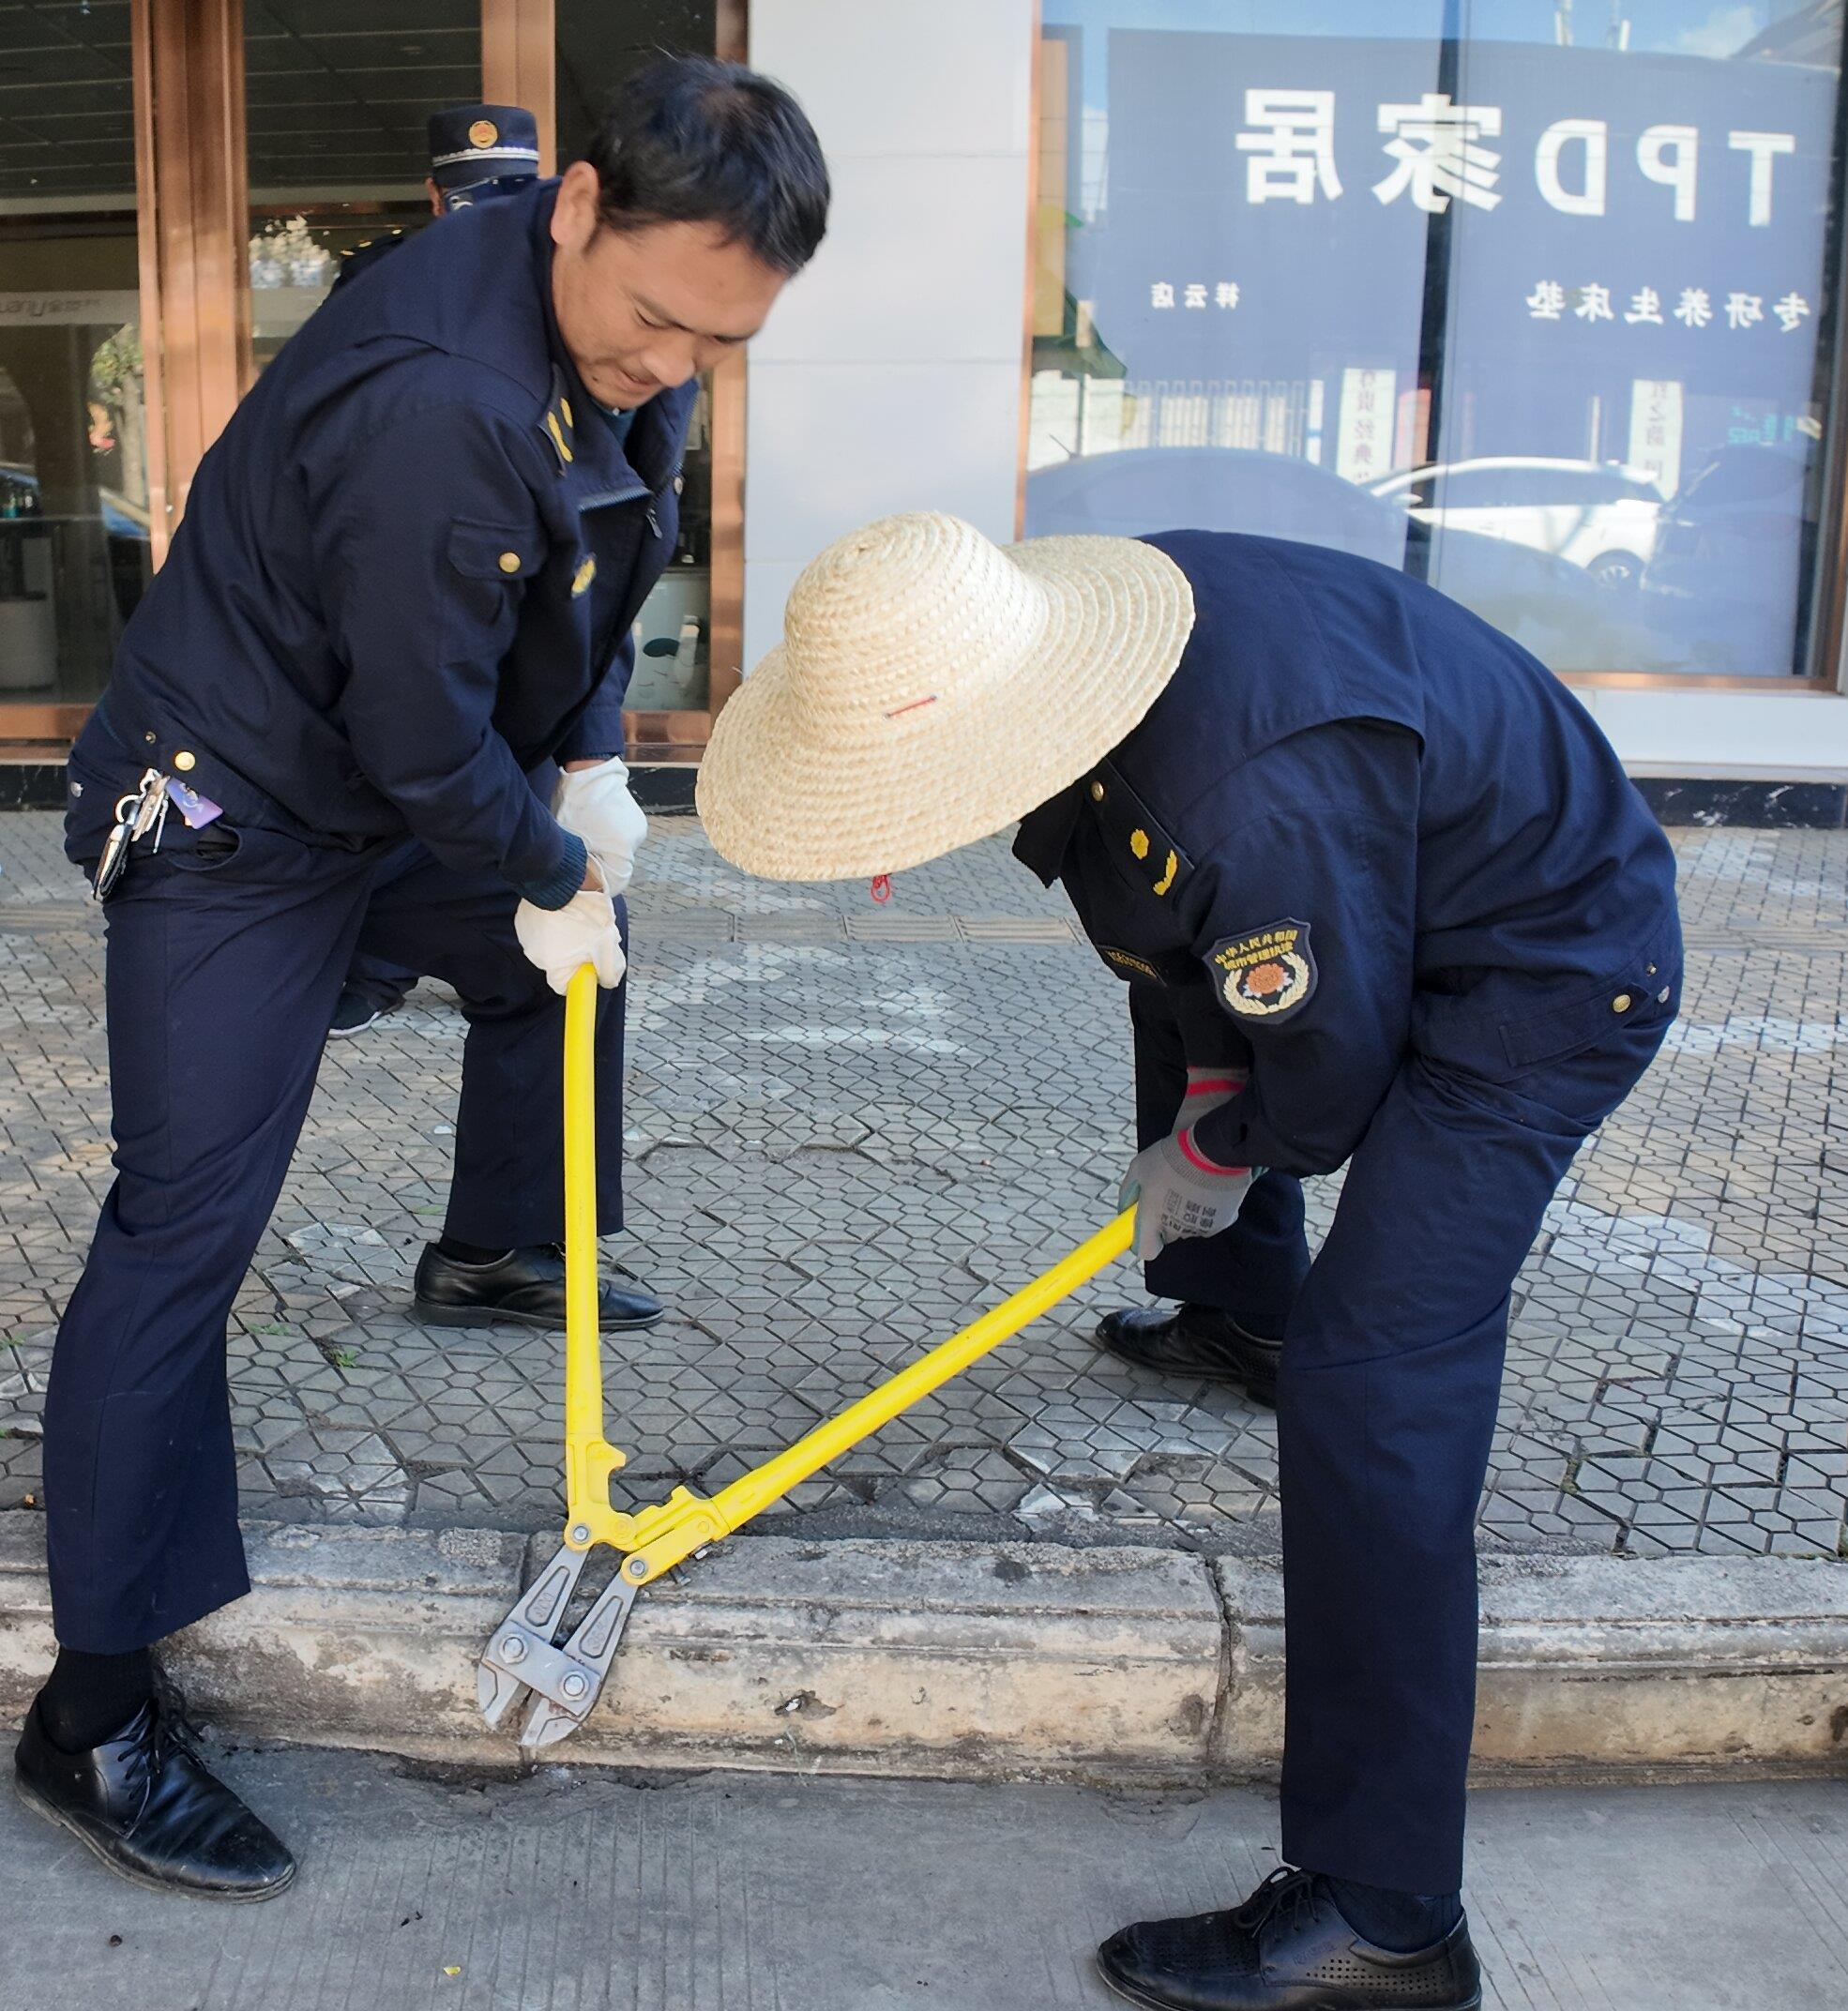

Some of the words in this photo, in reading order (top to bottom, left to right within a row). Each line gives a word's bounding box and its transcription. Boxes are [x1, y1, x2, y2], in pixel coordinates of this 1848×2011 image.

[1214, 930, 1298, 965] 中华人民共和国
